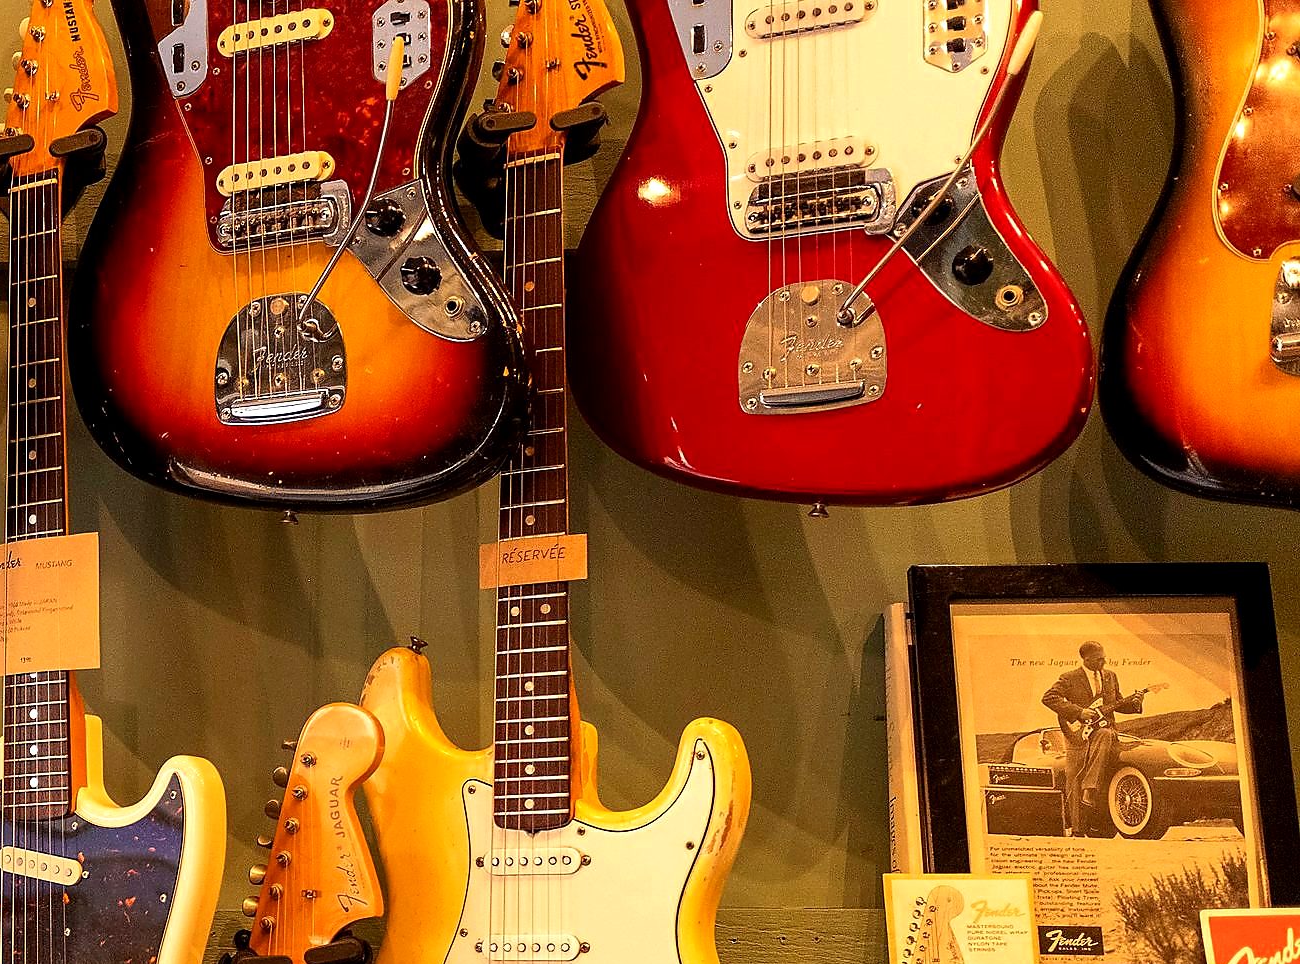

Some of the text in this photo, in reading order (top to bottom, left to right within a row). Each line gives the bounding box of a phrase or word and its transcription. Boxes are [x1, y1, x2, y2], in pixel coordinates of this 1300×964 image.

[63, 0, 100, 111] Fender MUSTAN
[570, 14, 608, 80] Fender
[250, 344, 308, 373] Fender
[780, 334, 844, 363] Fender
[35, 560, 73, 570] MUSTANG
[502, 544, 566, 564] RÉSERVÉE
[1010, 658, 1026, 667] The
[1048, 658, 1078, 667] Jaguar
[1108, 659, 1118, 667] by
[1122, 658, 1152, 666] Fender
[330, 775, 345, 838] JAGUAR
[970, 900, 1026, 923] Fender
[1046, 930, 1098, 952] Fender
